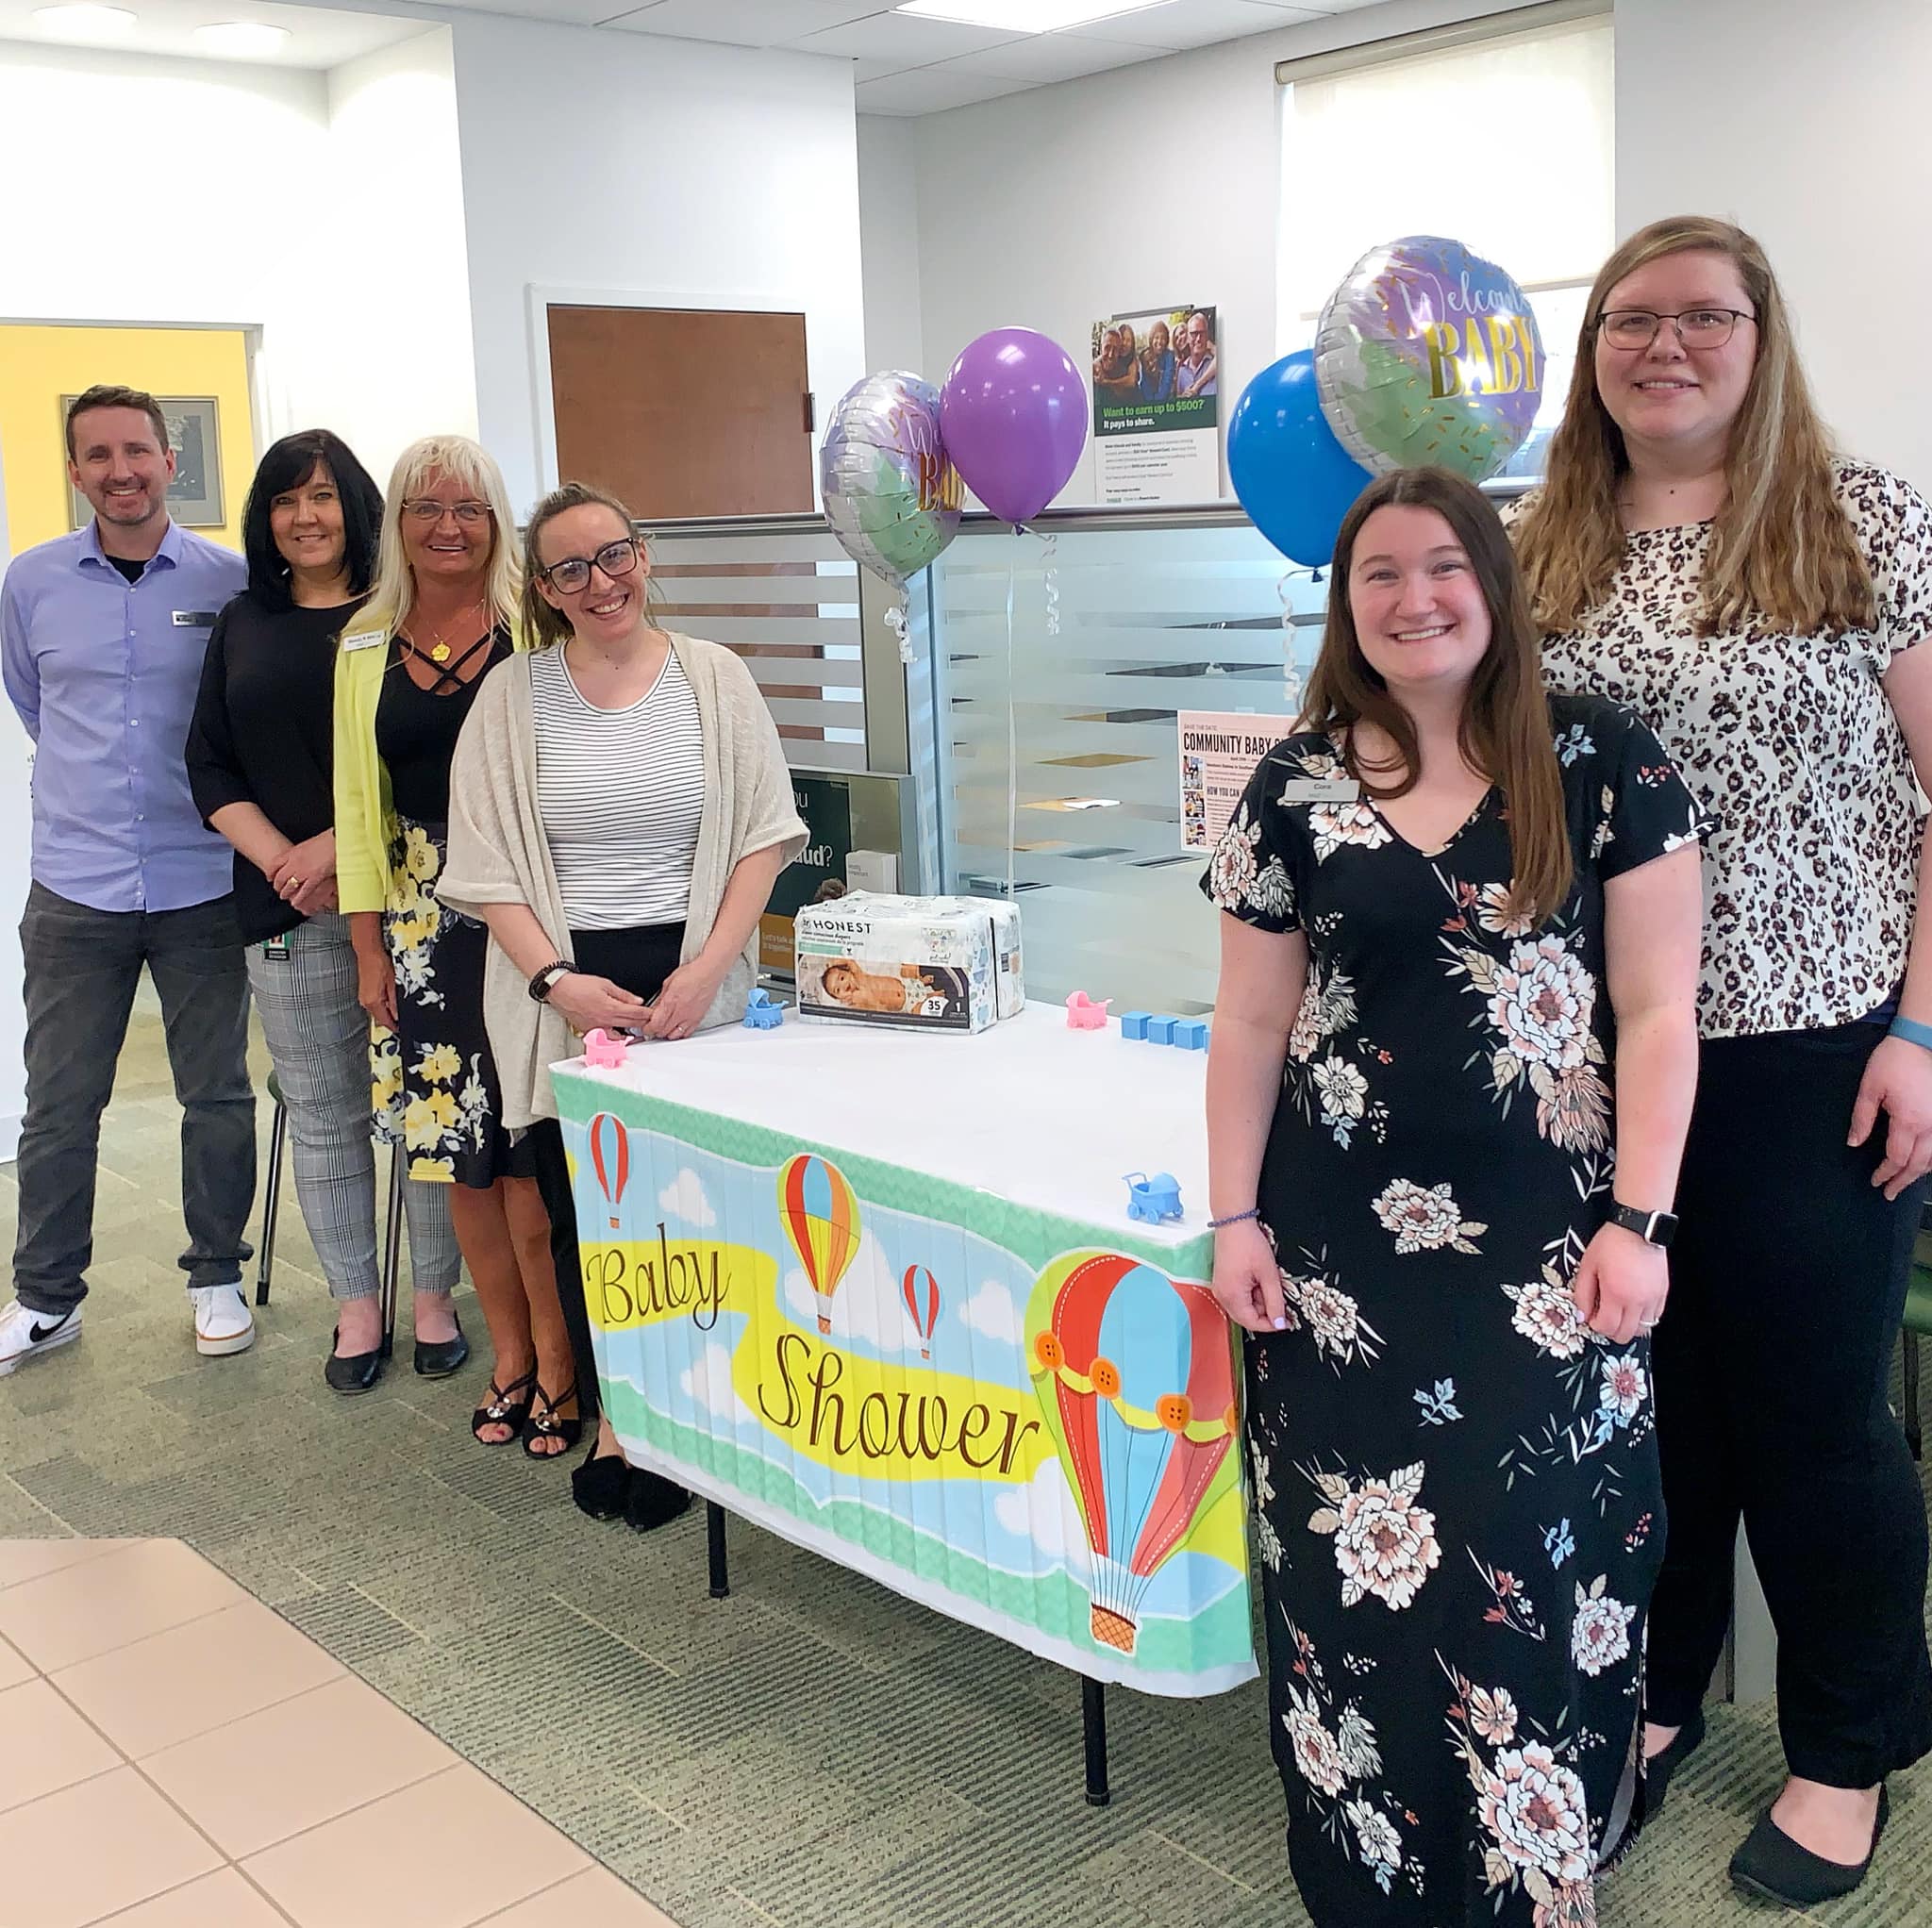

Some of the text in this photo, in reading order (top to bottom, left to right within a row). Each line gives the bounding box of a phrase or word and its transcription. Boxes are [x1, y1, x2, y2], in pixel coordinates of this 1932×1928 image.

[1424, 315, 1539, 400] BABY
[1103, 399, 1206, 417] Want to earn up to $500?
[1104, 418, 1155, 430] It pays to share.
[1183, 732, 1272, 756] COMMUNITY BABY
[1207, 786, 1218, 796] HOW
[1229, 788, 1240, 797] CAN
[813, 920, 872, 935] HONEST
[927, 1000, 941, 1011] 35
[955, 1002, 961, 1012] 1
[586, 1222, 732, 1331] Baby
[758, 1333, 1041, 1474] Shower
